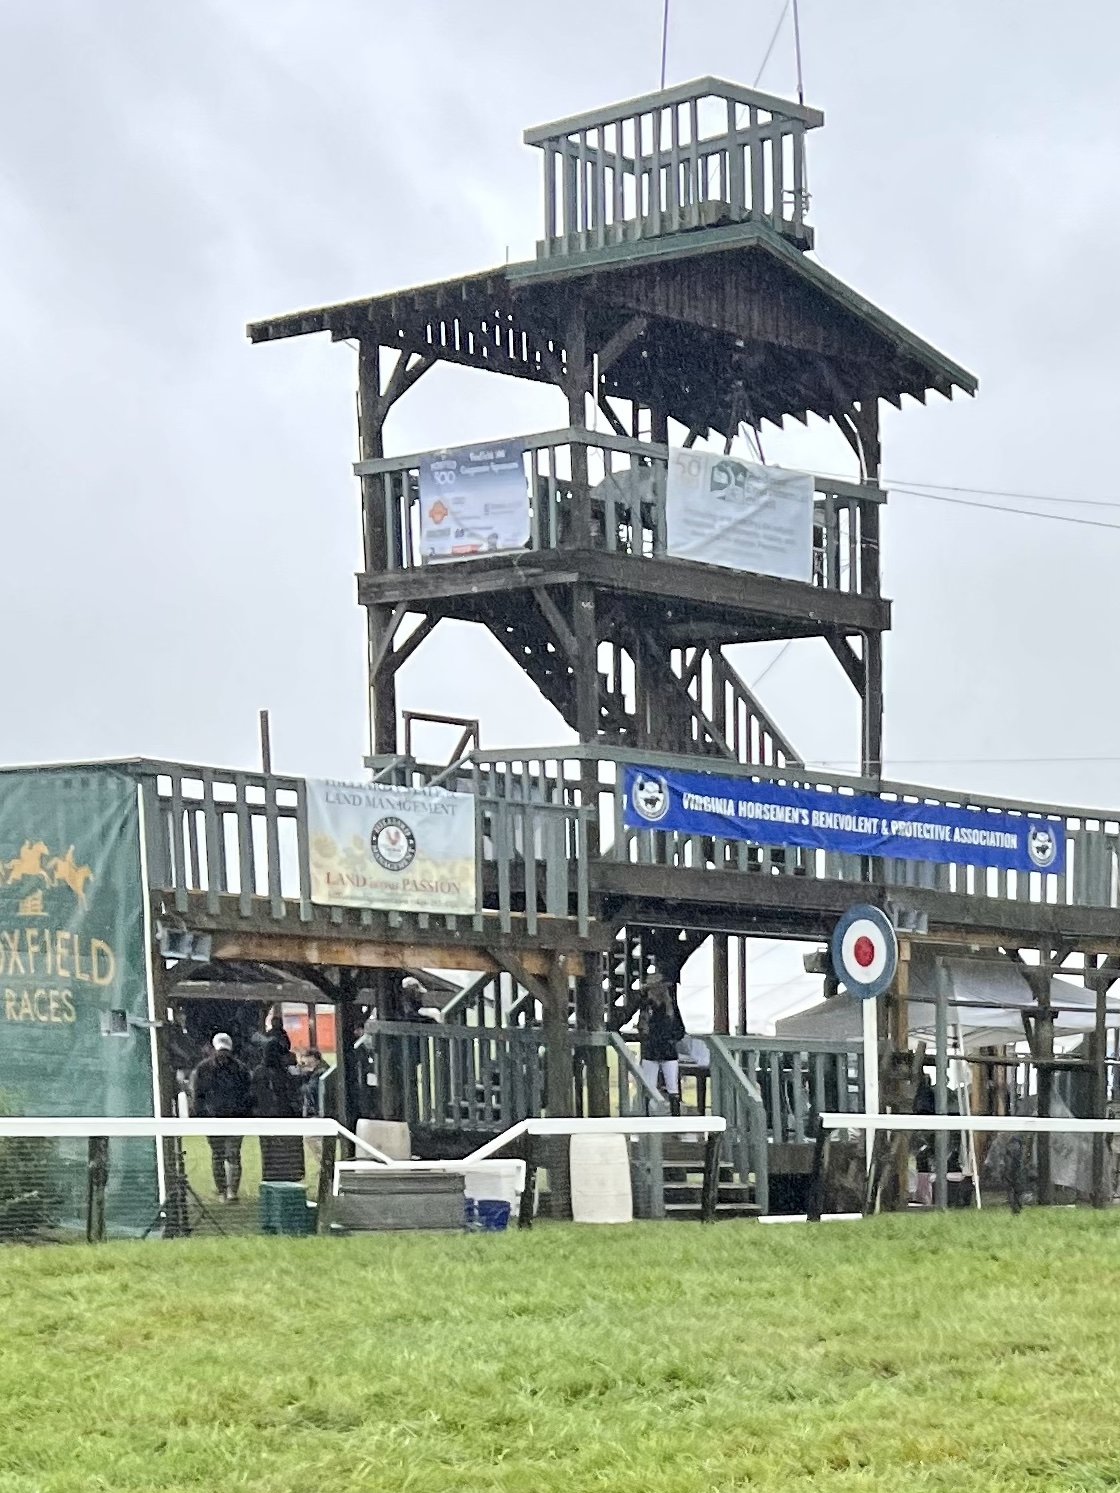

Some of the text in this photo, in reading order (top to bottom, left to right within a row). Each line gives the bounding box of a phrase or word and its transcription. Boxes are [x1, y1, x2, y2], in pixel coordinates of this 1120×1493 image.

[325, 792, 457, 816] LAND MANAGEMENT
[682, 792, 1018, 850] VIRGINIA HORSEMEN'S BENEVOLENT & PROTECTIVE ASSOCIATION
[326, 871, 367, 888] LAND
[402, 878, 461, 894] PASSION
[0, 928, 116, 986] XFIELD
[5, 988, 77, 1023] RACES
